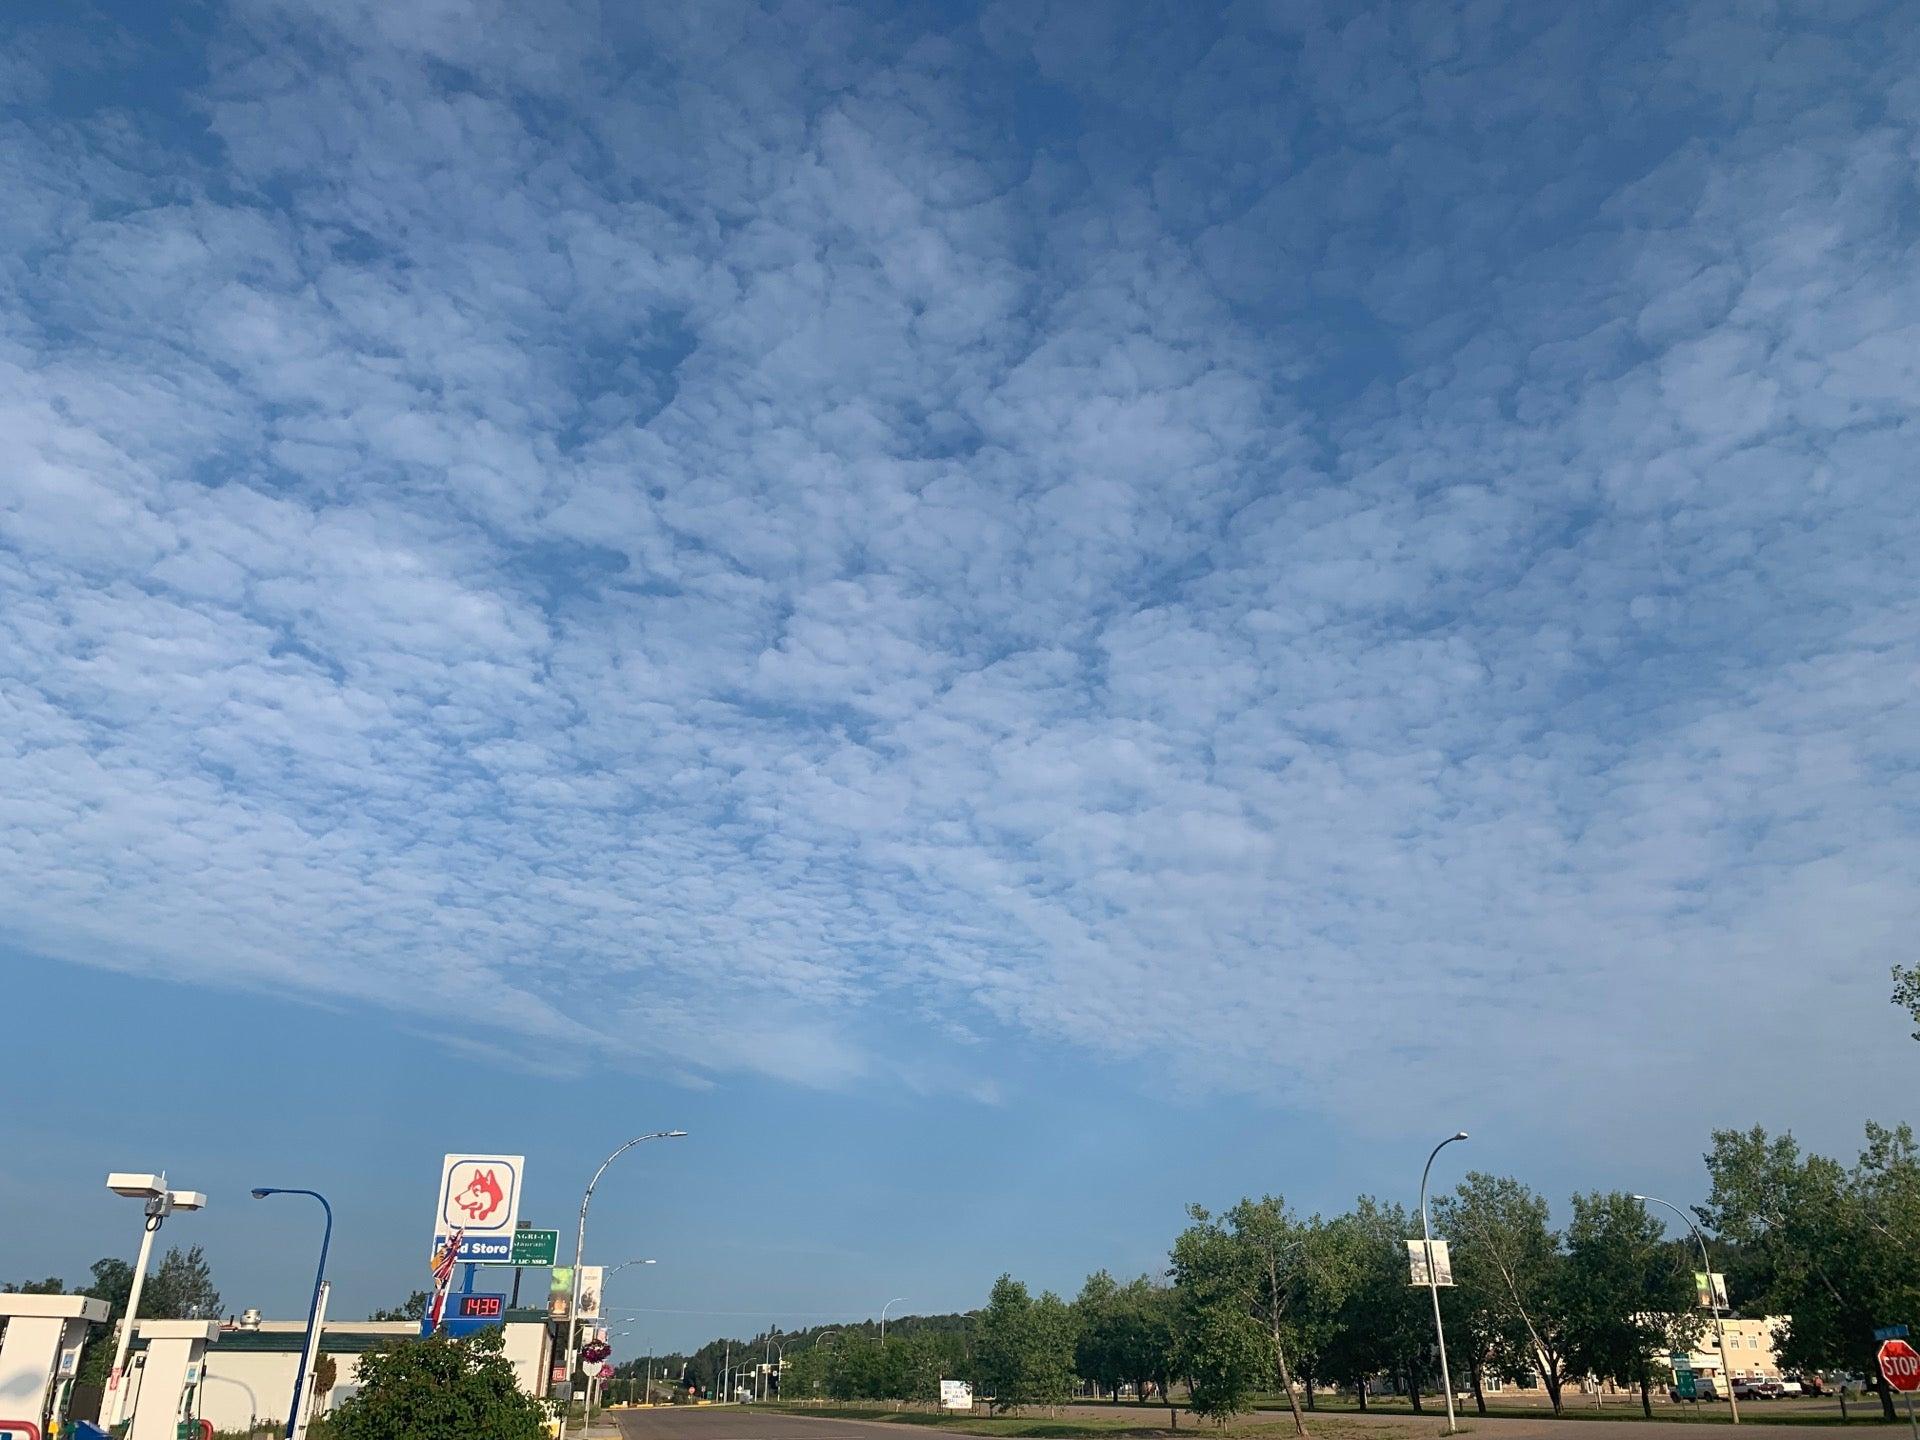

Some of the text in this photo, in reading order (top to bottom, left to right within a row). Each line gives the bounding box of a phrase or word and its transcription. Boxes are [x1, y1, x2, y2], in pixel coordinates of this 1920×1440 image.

[437, 1243, 469, 1254] Fd
[472, 1242, 508, 1254] Store
[1884, 1357, 1918, 1376] STOP
